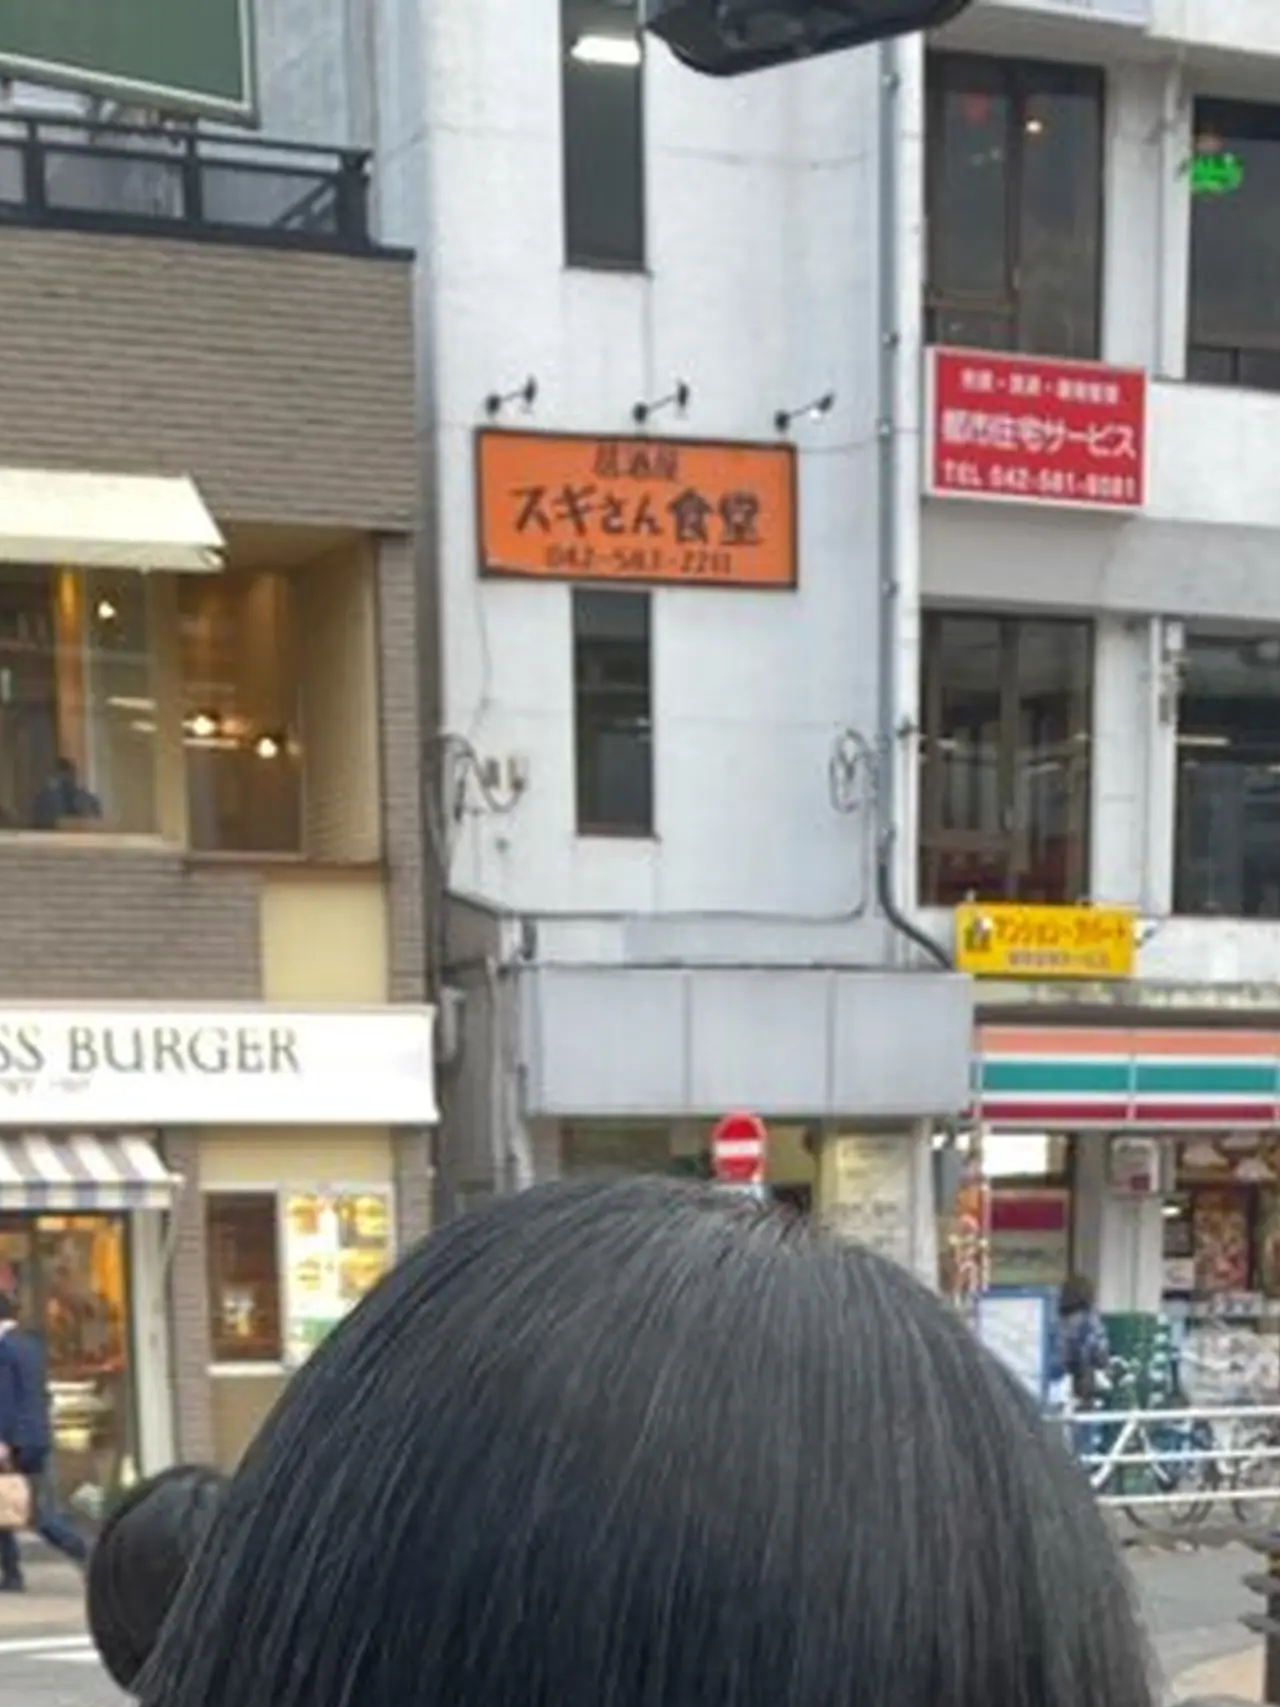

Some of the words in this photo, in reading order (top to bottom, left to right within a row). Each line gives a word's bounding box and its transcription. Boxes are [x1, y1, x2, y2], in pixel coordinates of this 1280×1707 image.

[508, 484, 765, 546] スギさん食堂
[68, 1024, 301, 1074] BURGER
